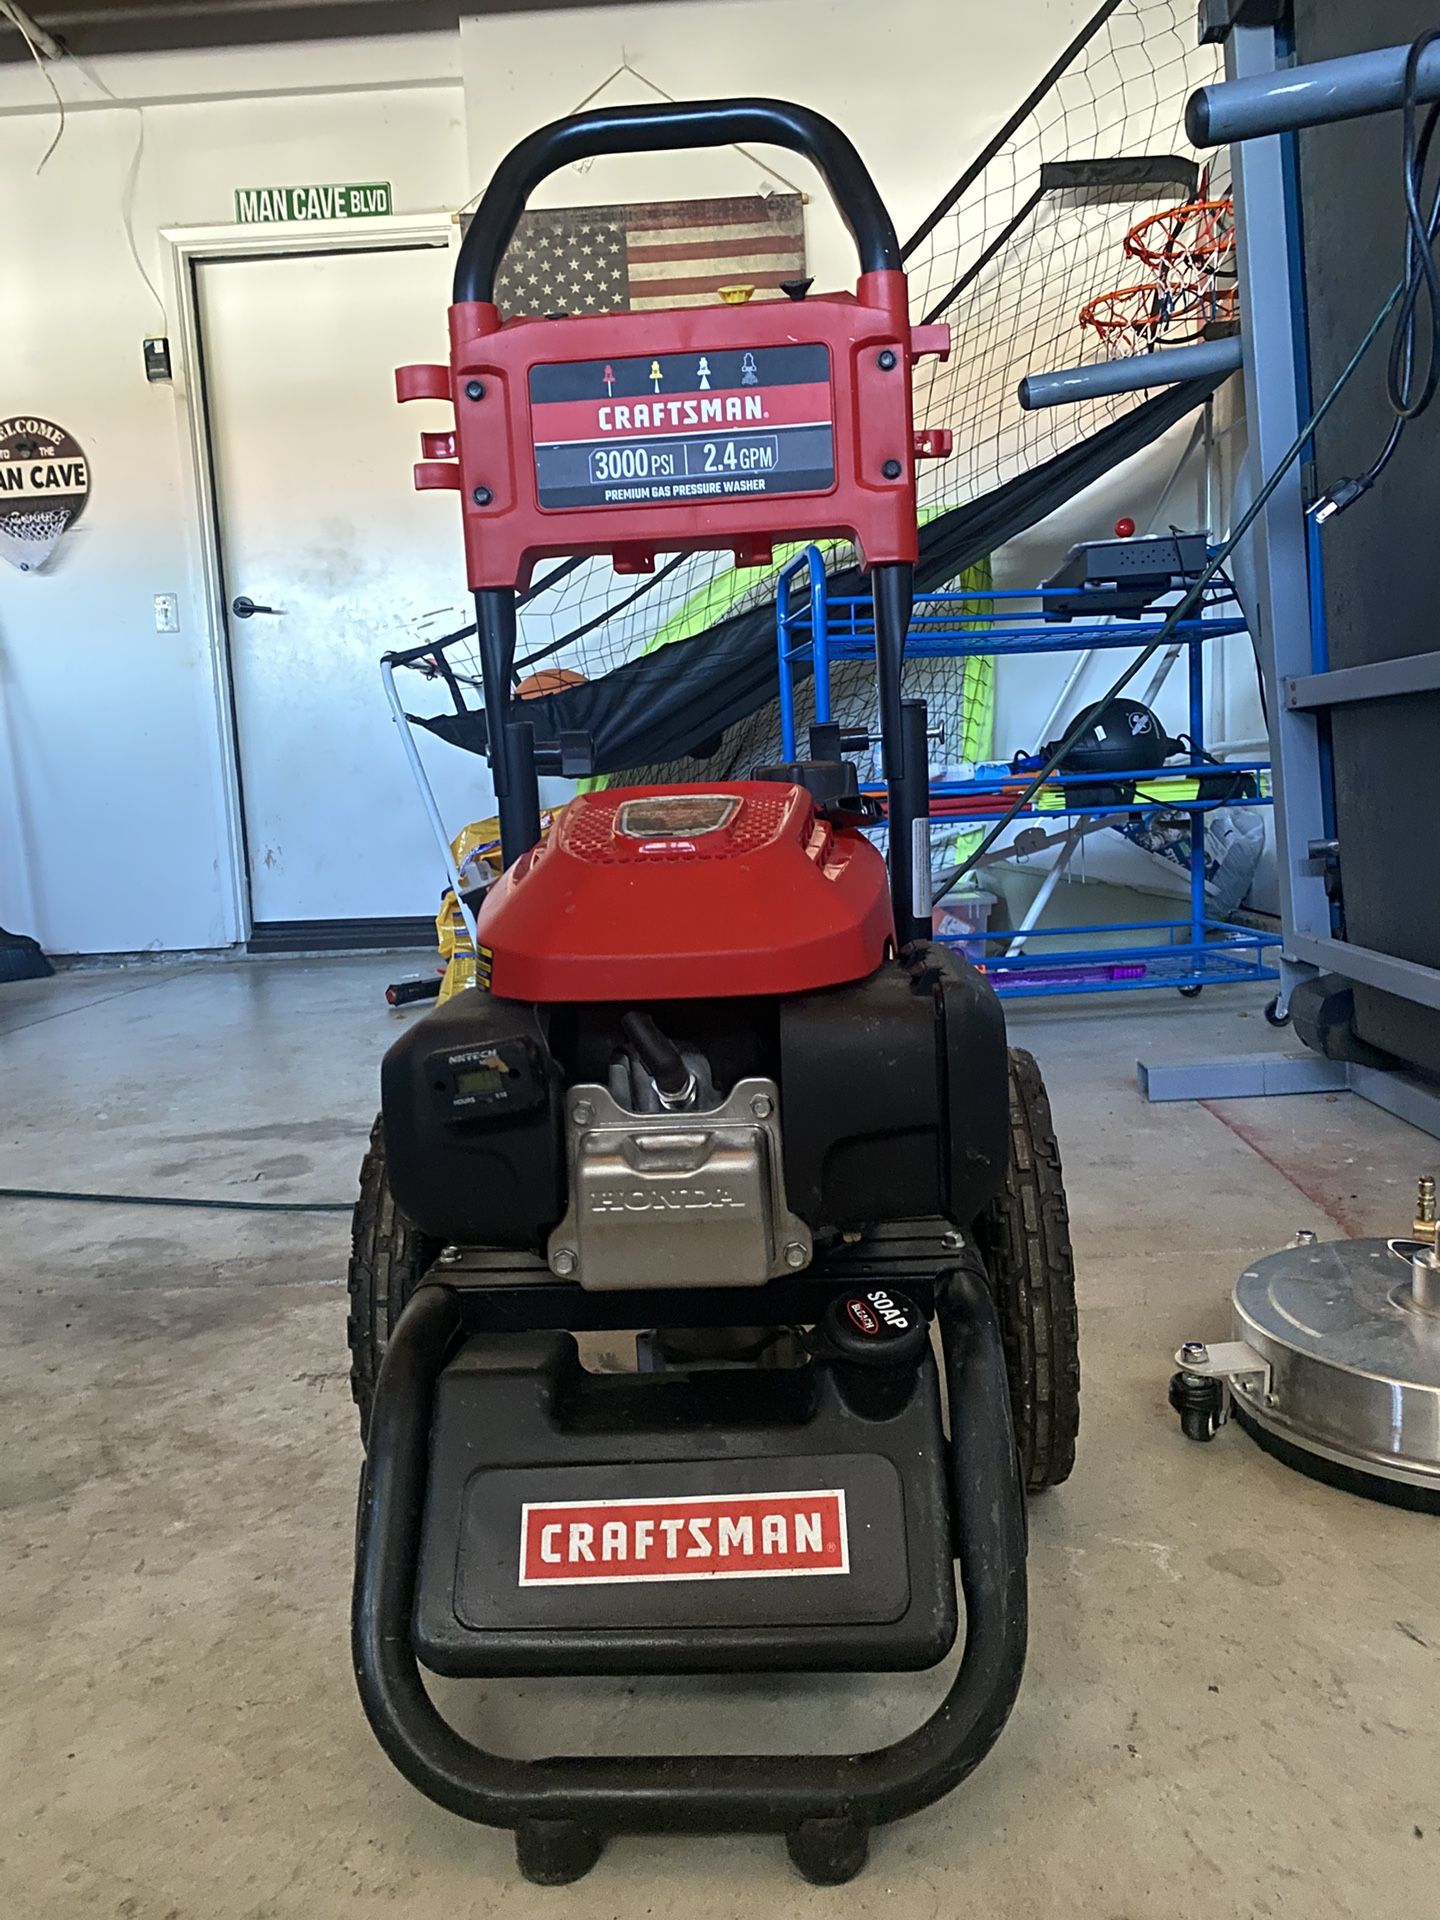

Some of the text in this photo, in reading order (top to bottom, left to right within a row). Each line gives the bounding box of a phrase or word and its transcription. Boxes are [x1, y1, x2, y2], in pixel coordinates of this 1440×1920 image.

[239, 186, 387, 222] MAN CAVE BLVD
[598, 395, 764, 431] CRAFTSMAN
[0, 419, 65, 446] ELCOME
[39, 446, 55, 457] THE
[595, 441, 773, 480] 3000 PSI 2.4 GPM
[0, 463, 86, 491] AN CAVE
[605, 479, 765, 501] PREMIUM GAS PRESSURE WASHER
[590, 1189, 746, 1212] HONDA
[867, 1290, 909, 1329] SOAP
